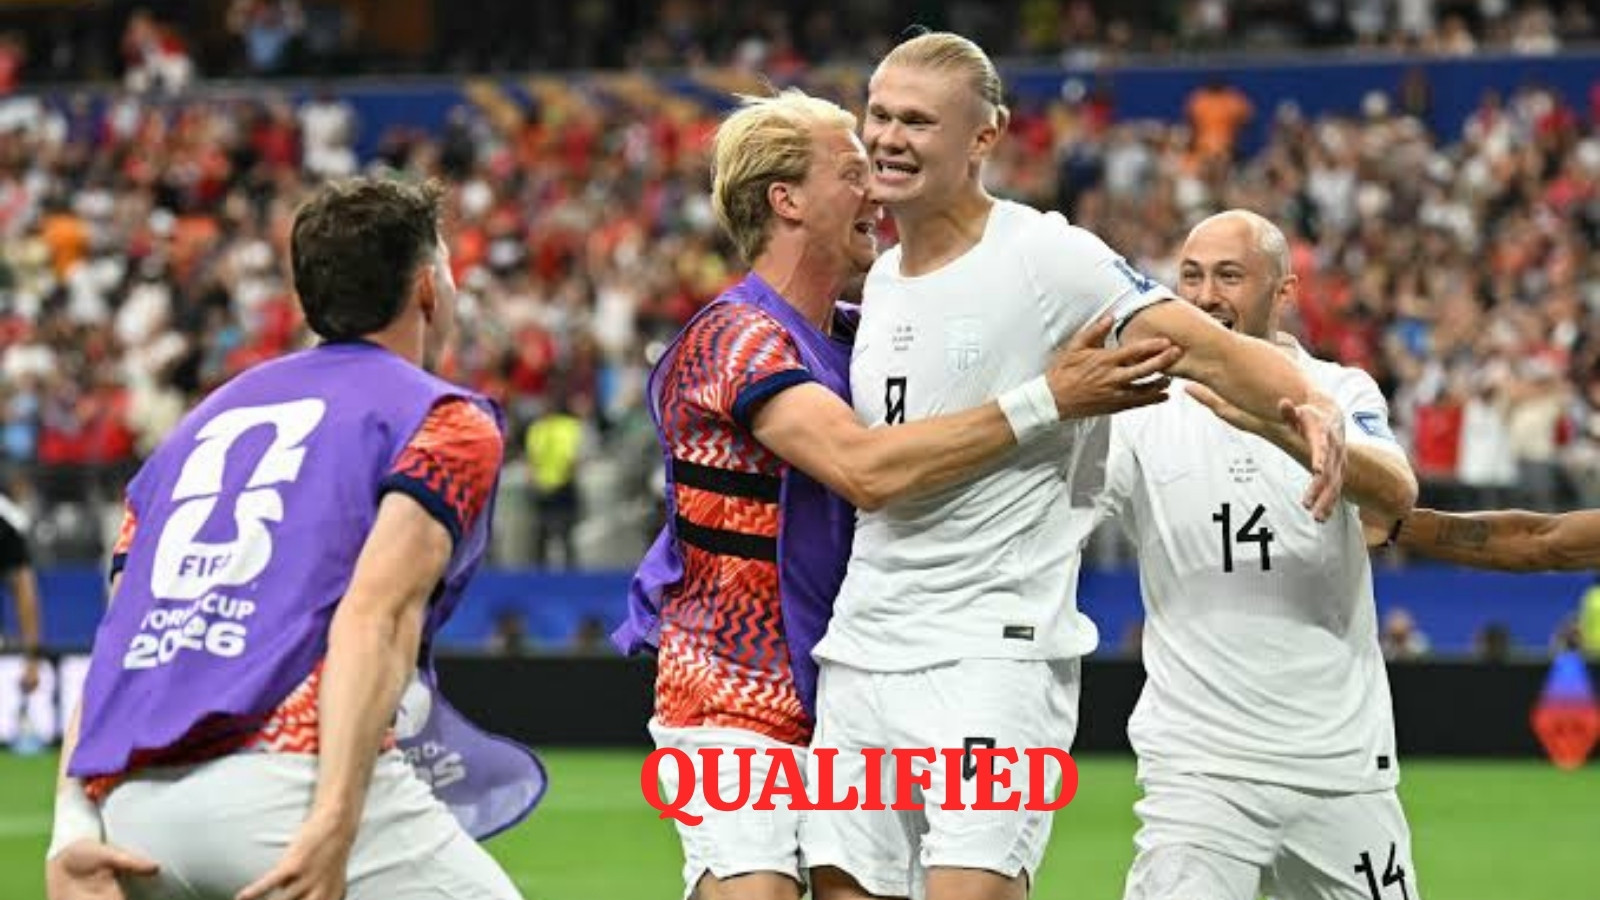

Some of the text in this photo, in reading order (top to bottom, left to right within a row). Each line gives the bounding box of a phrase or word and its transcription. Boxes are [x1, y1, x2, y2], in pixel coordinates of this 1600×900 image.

[1212, 502, 1274, 573] 14
[178, 552, 232, 577] FIF
[202, 592, 256, 620] CUP
[1354, 841, 1409, 900] 14
